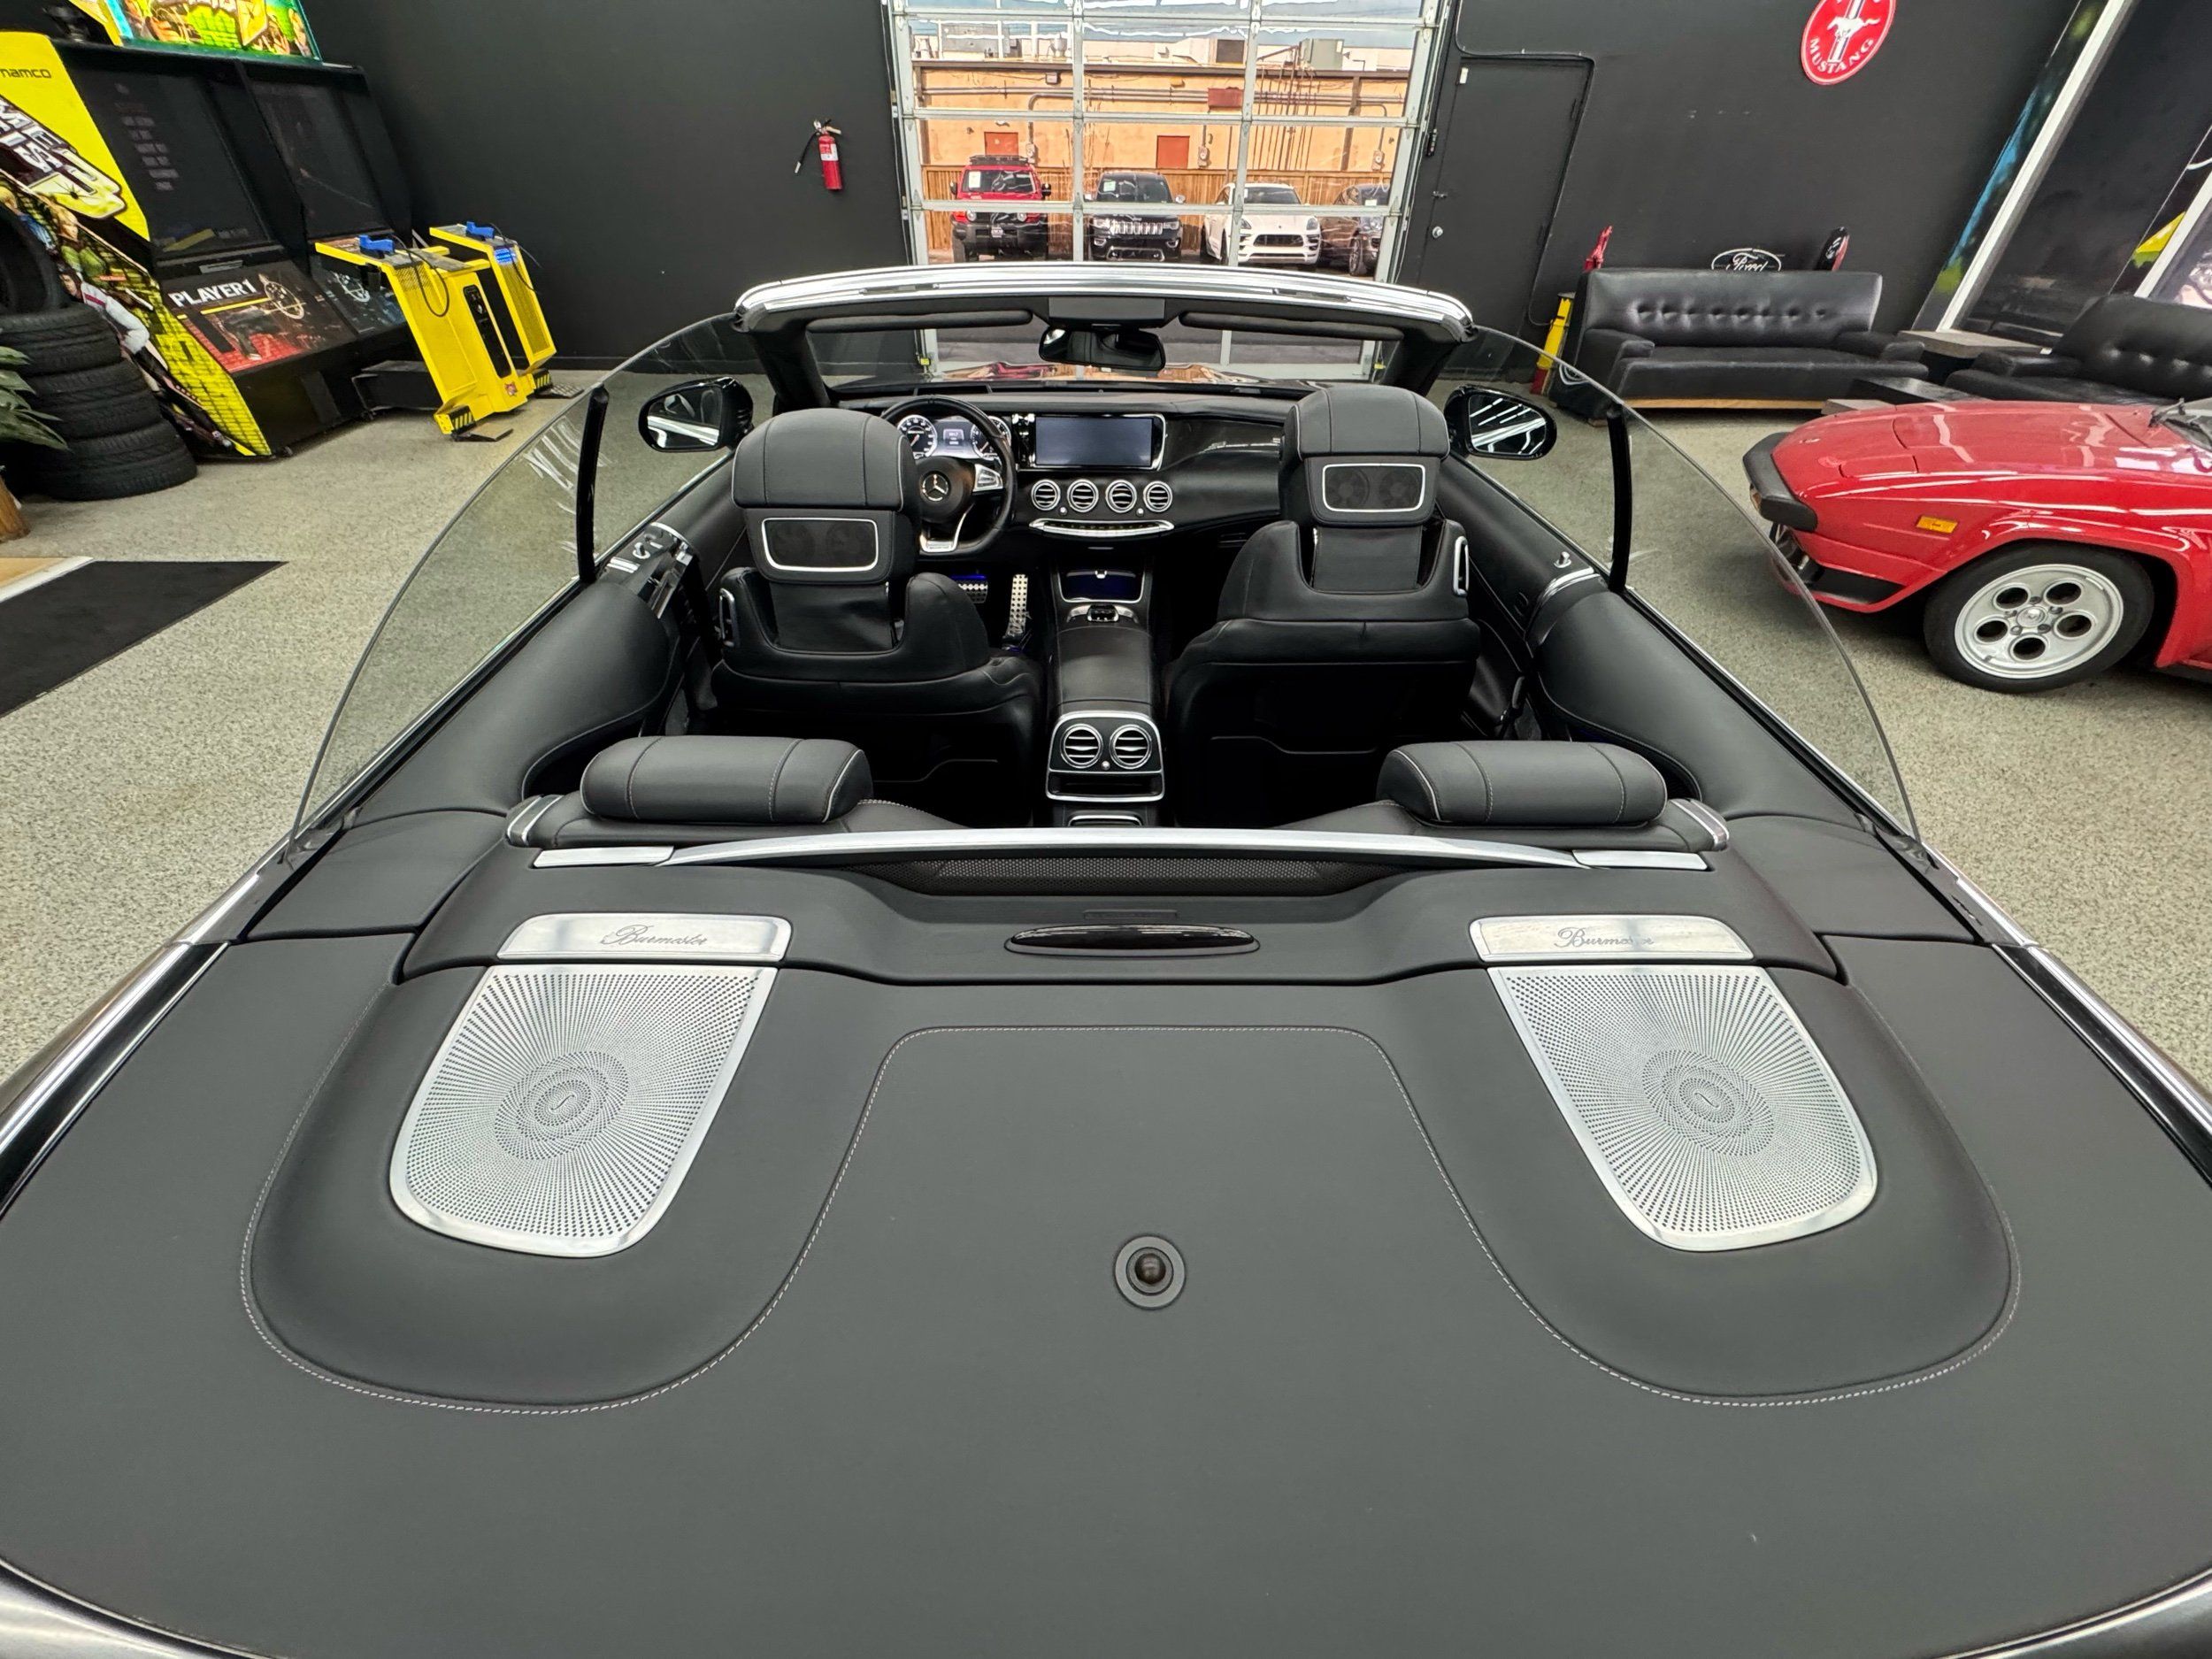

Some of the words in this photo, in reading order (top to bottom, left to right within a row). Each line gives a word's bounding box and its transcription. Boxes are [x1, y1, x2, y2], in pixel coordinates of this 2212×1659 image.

[1809, 36, 1874, 73] MUSTANG
[0, 68, 52, 78] namco
[600, 925, 708, 946] Burmester
[1554, 926, 1655, 949] Burmeser
